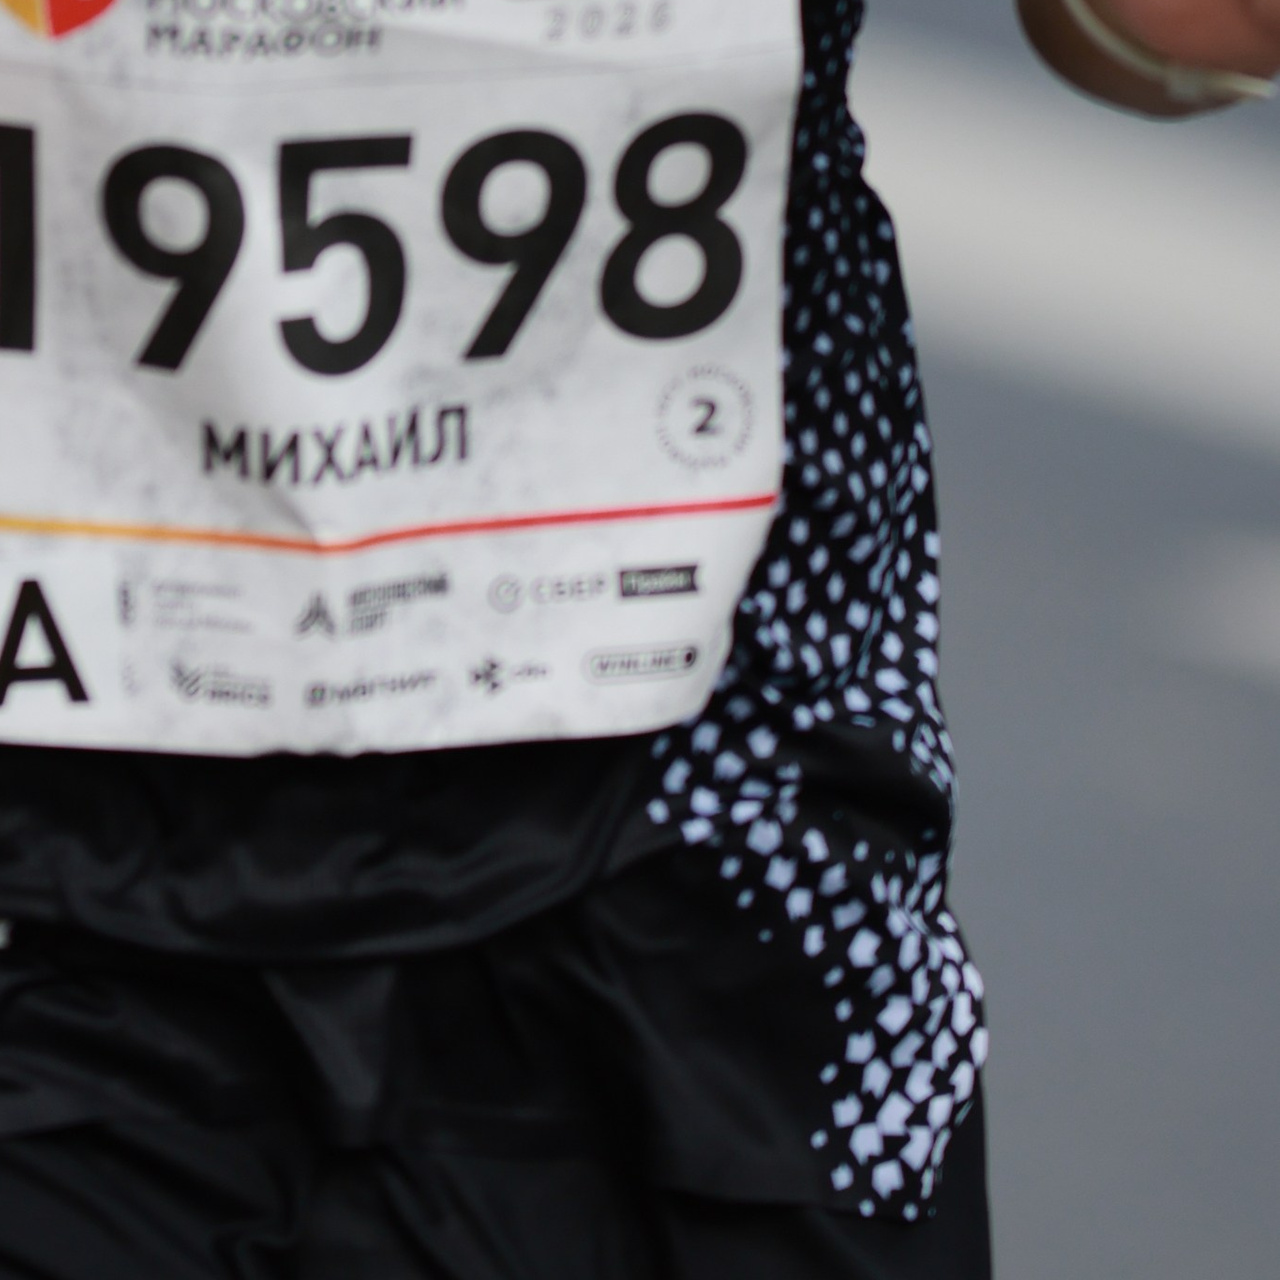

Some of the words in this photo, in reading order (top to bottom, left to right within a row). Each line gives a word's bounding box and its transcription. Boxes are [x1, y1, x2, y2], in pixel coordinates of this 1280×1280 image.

[146, 20, 385, 59] МАРАФОН
[689, 396, 722, 438] 2
[200, 400, 472, 486] МИХАИЛ
